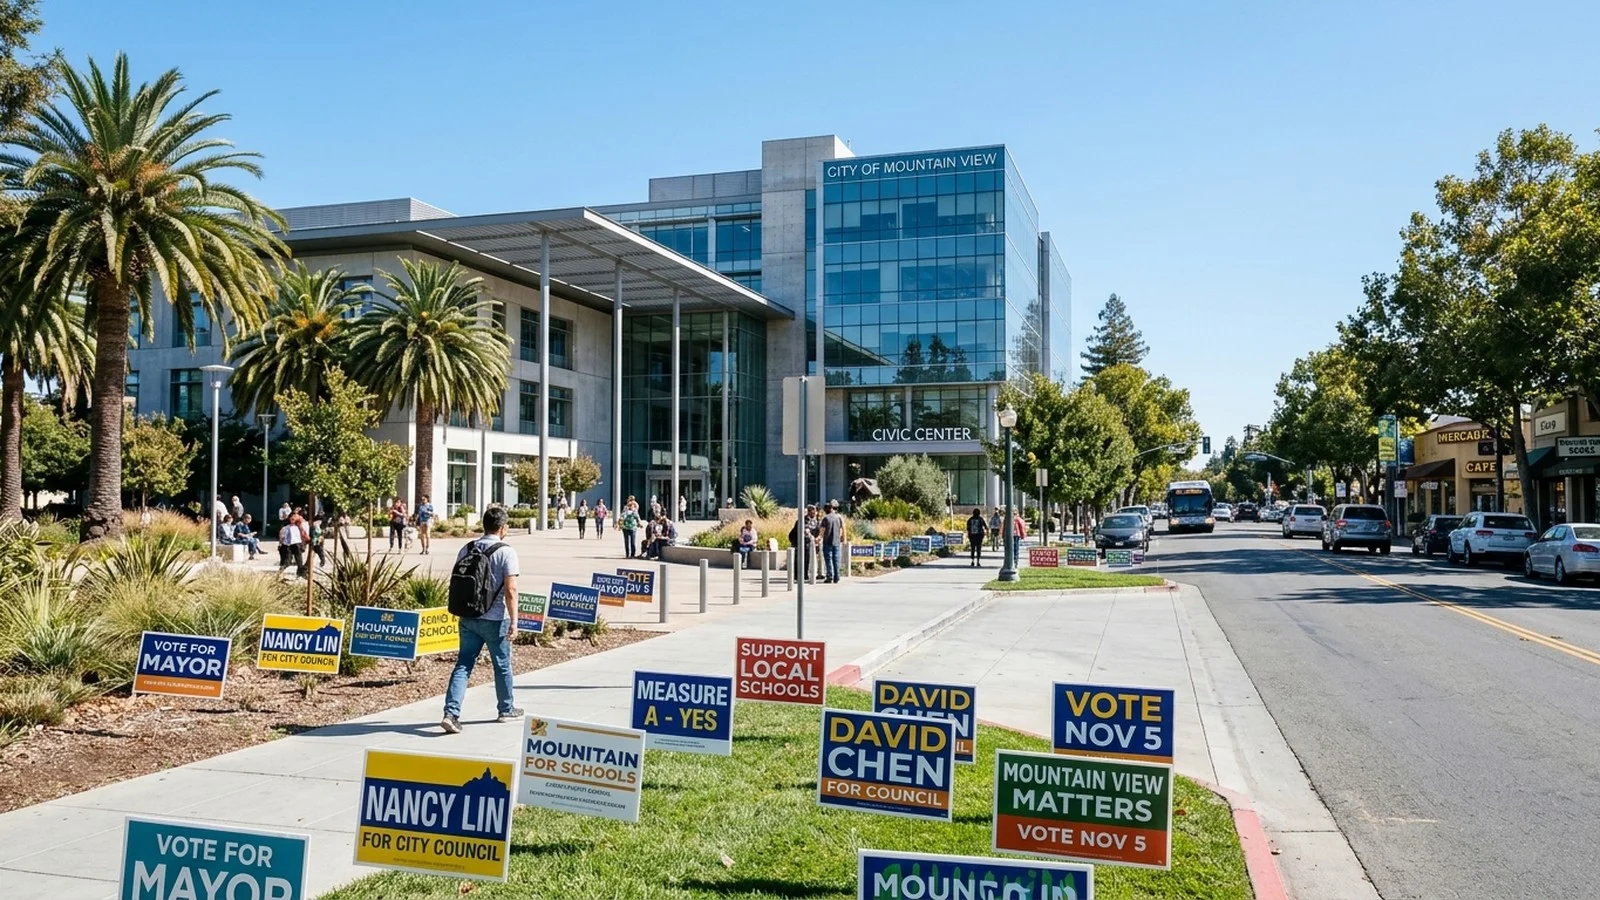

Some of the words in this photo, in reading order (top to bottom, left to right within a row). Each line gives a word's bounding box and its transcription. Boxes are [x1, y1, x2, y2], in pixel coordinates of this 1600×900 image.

[828, 165, 857, 178] CITY
[862, 163, 880, 175] OF
[884, 157, 956, 174] MOUNTAIN
[960, 153, 996, 167] VIEW
[873, 428, 910, 441] CIVIC
[915, 428, 971, 440] CENTER
[154, 641, 187, 653] VOTE
[190, 644, 216, 655] FOR
[264, 631, 313, 650] NANCY
[315, 635, 338, 652] LIN
[741, 643, 820, 660] SUPPORT
[142, 653, 221, 676] MAYOR
[280, 654, 298, 663] CITY
[741, 659, 819, 682] LOCAL
[638, 680, 728, 706] MEASURE
[740, 680, 819, 698] SCHOOLS
[880, 684, 970, 710] DAVID
[644, 706, 658, 726] A
[679, 708, 717, 731] YES
[1066, 690, 1162, 722] VOTE
[830, 717, 946, 752] DAVID
[1066, 721, 1136, 748] NOV
[1144, 727, 1162, 750] 5
[527, 739, 638, 768] MOUNITAIN
[828, 746, 944, 787] CHEN
[526, 756, 557, 771] FOR
[562, 763, 636, 783] SCHOOLS
[1003, 762, 1105, 790] MOUNTAIN
[1112, 772, 1164, 795] VIEW
[827, 781, 861, 796] FOR
[866, 786, 942, 806] COUNCIL
[1013, 788, 1152, 822] MATTERS
[366, 786, 456, 828] NANCY
[462, 795, 505, 834] LIN
[362, 832, 391, 849] FOR
[396, 836, 430, 853] CITY
[434, 839, 500, 861] COUNCIL
[1017, 824, 1073, 844] VOTE
[1081, 831, 1128, 850] NOV
[1134, 836, 1146, 851] 5
[157, 834, 217, 861] VOTE
[224, 842, 273, 868] FOR
